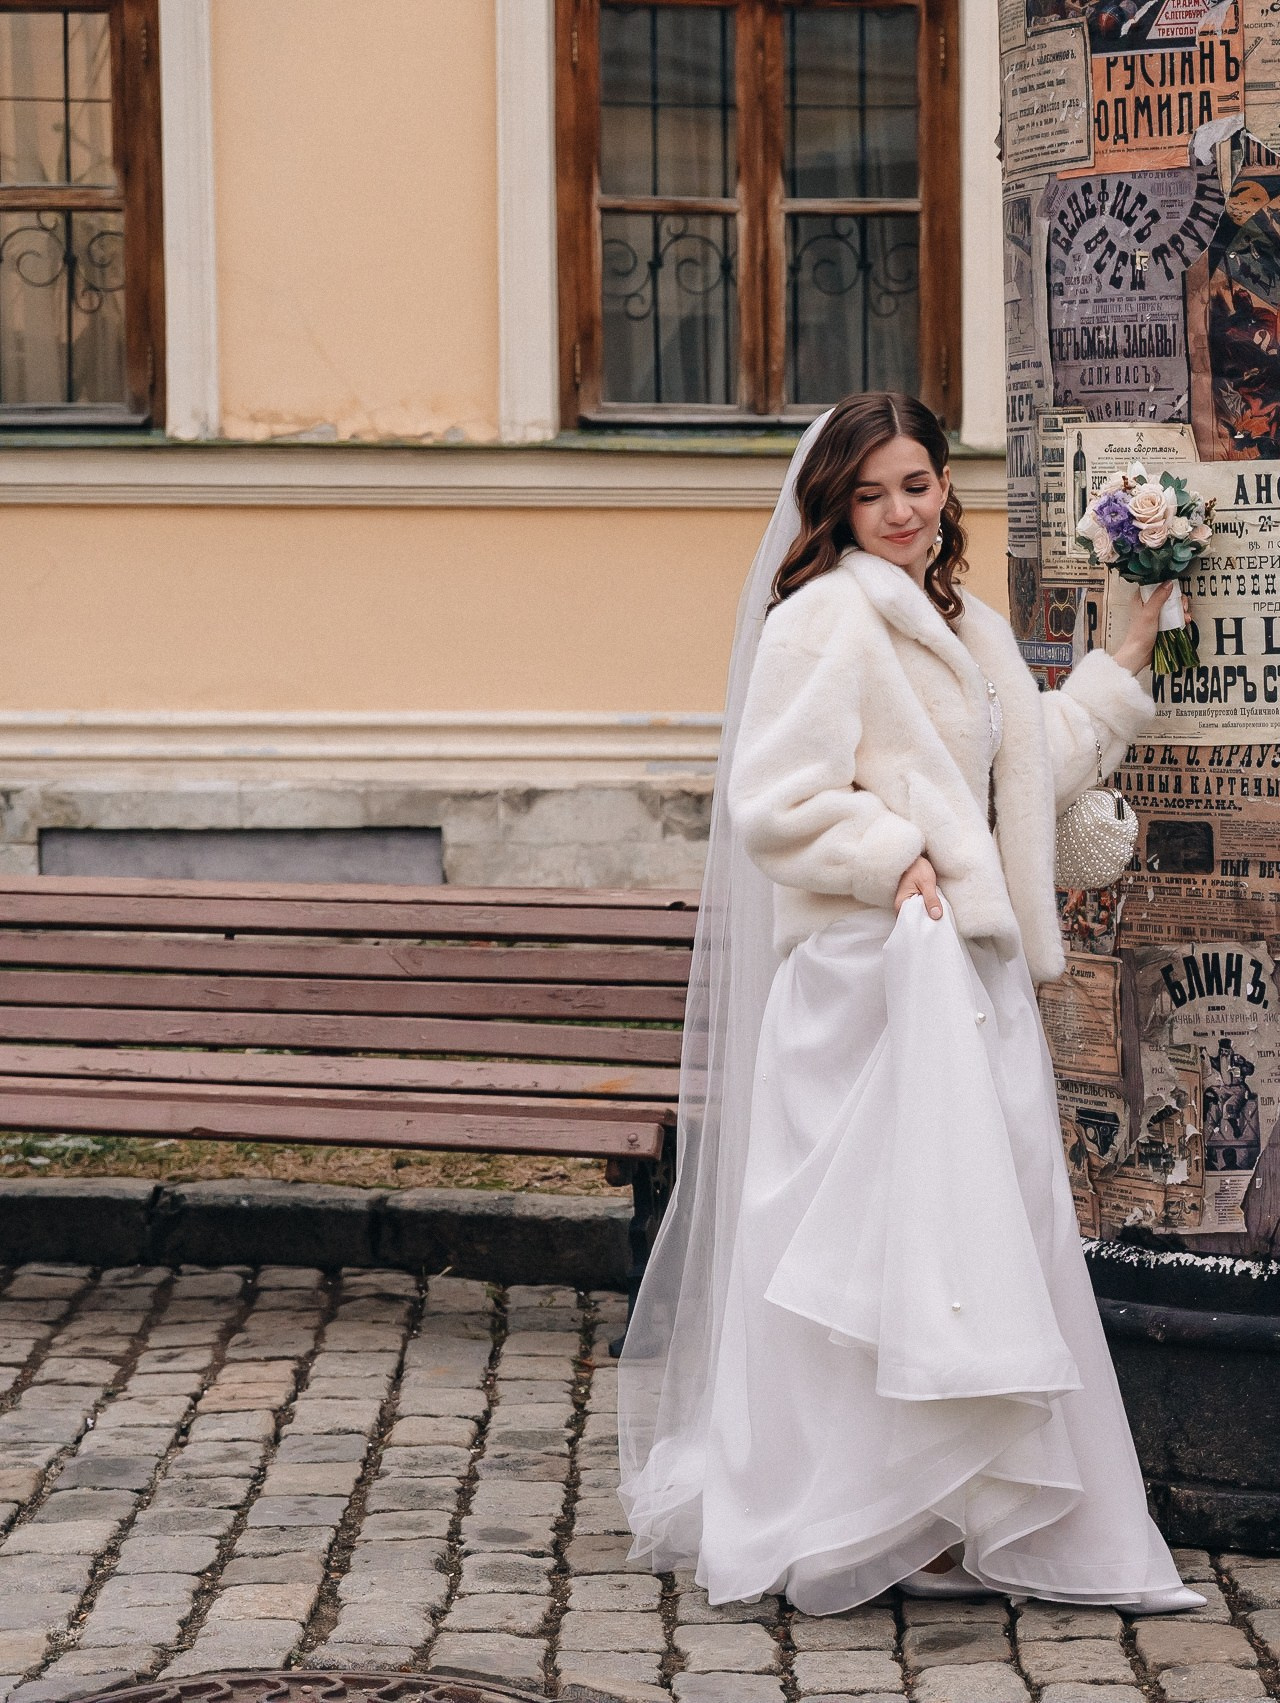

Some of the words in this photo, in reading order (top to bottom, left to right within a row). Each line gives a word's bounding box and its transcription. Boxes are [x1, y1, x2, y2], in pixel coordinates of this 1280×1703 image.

[1170, 665, 1257, 704] БАЗАРЪ
[1175, 708, 1237, 718] Екатеринбургской
[1240, 707, 1280, 717] Публичной
[1160, 952, 1269, 1010] БЛИНЪ.
